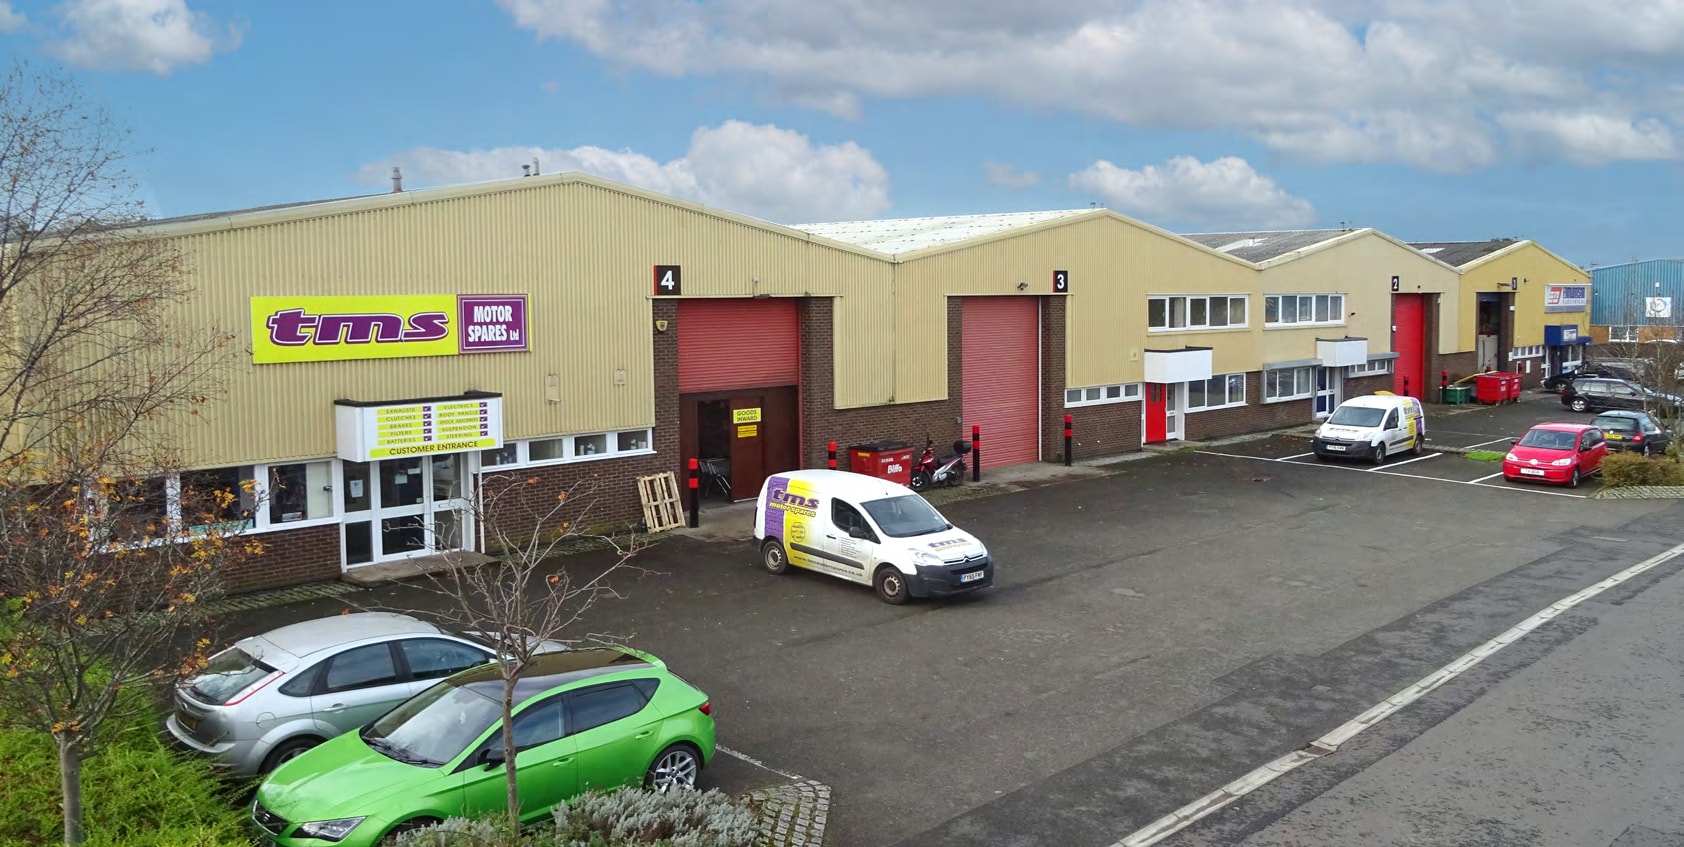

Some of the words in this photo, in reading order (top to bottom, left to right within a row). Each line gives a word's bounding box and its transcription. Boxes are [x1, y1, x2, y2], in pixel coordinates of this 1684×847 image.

[661, 270, 675, 290] 4
[1057, 273, 1065, 290] 3
[1393, 278, 1398, 289] 2
[473, 305, 513, 323] MOTOR
[266, 308, 449, 346] tms
[468, 325, 507, 343] SPARES
[509, 329, 519, 341] Ltd
[387, 437, 416, 445] BATTERIES
[389, 445, 435, 456] CUSTOMER
[437, 440, 478, 451] ENTRANCE
[773, 487, 820, 509] tms
[928, 538, 967, 548] tms
